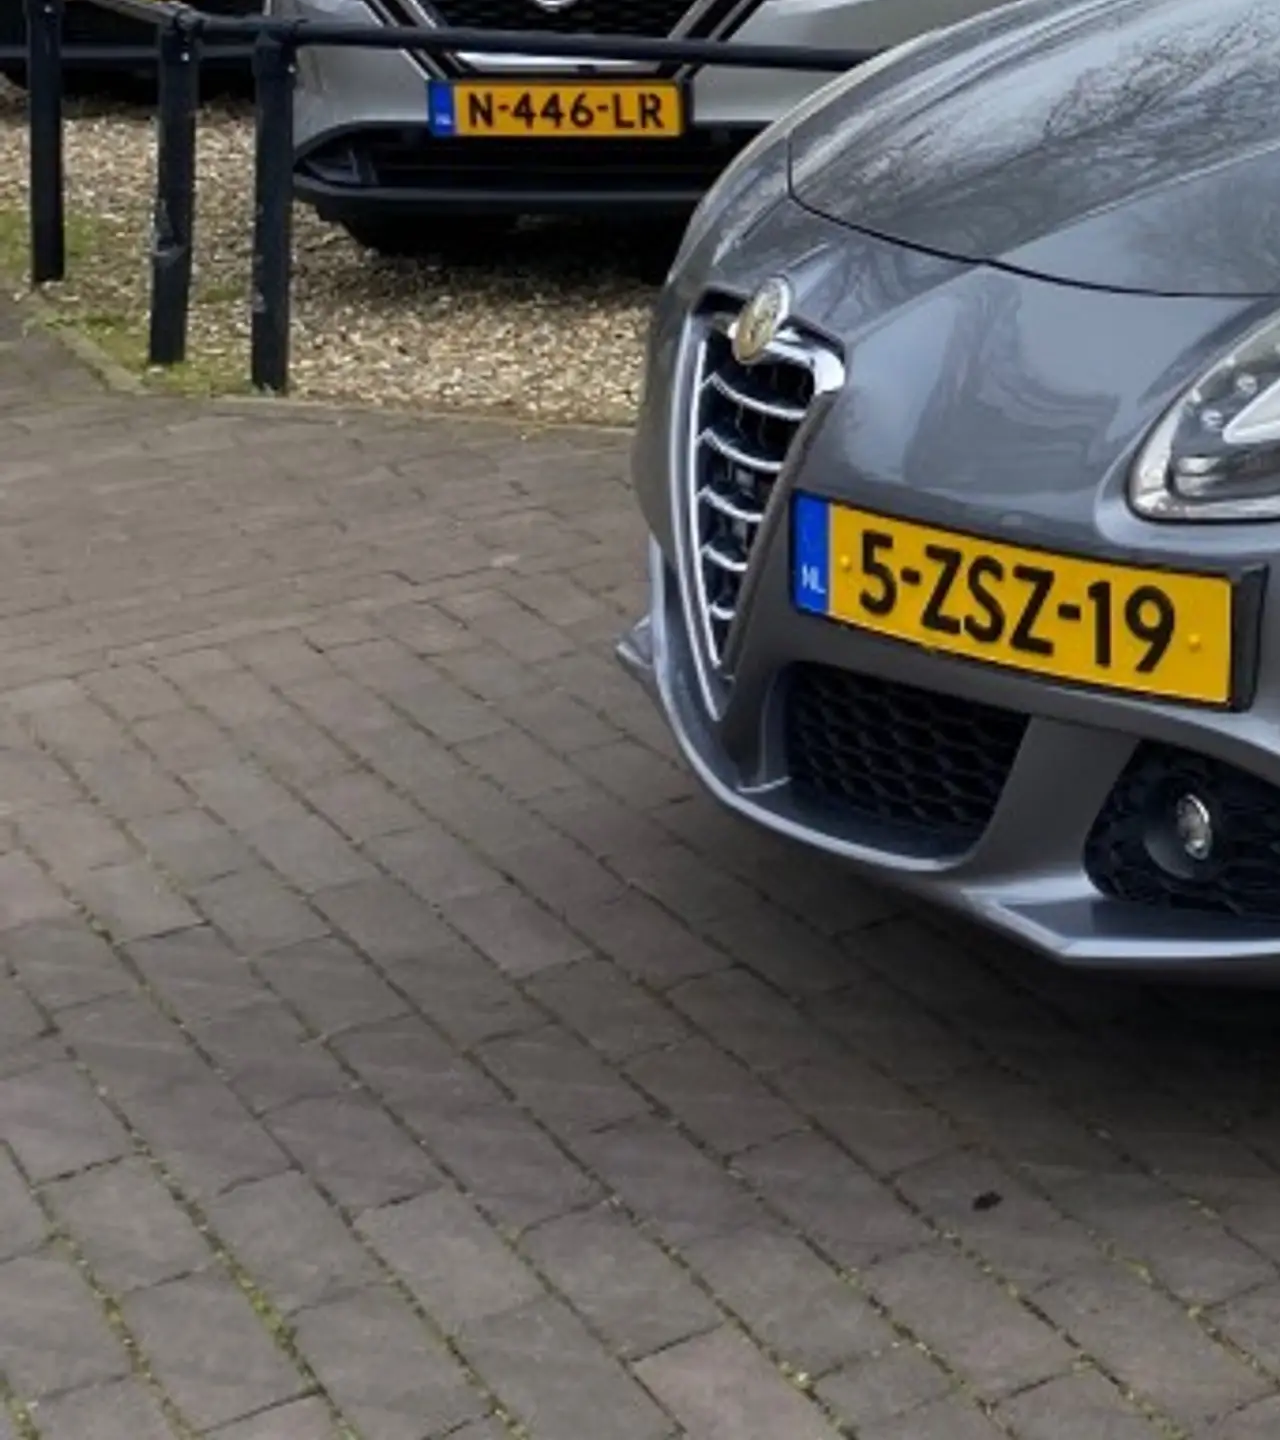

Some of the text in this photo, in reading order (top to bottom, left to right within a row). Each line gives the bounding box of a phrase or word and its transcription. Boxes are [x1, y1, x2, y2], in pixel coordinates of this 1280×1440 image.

[468, 92, 665, 129] N-446-LR
[801, 528, 1176, 674] NL 5-ZSZ-19
